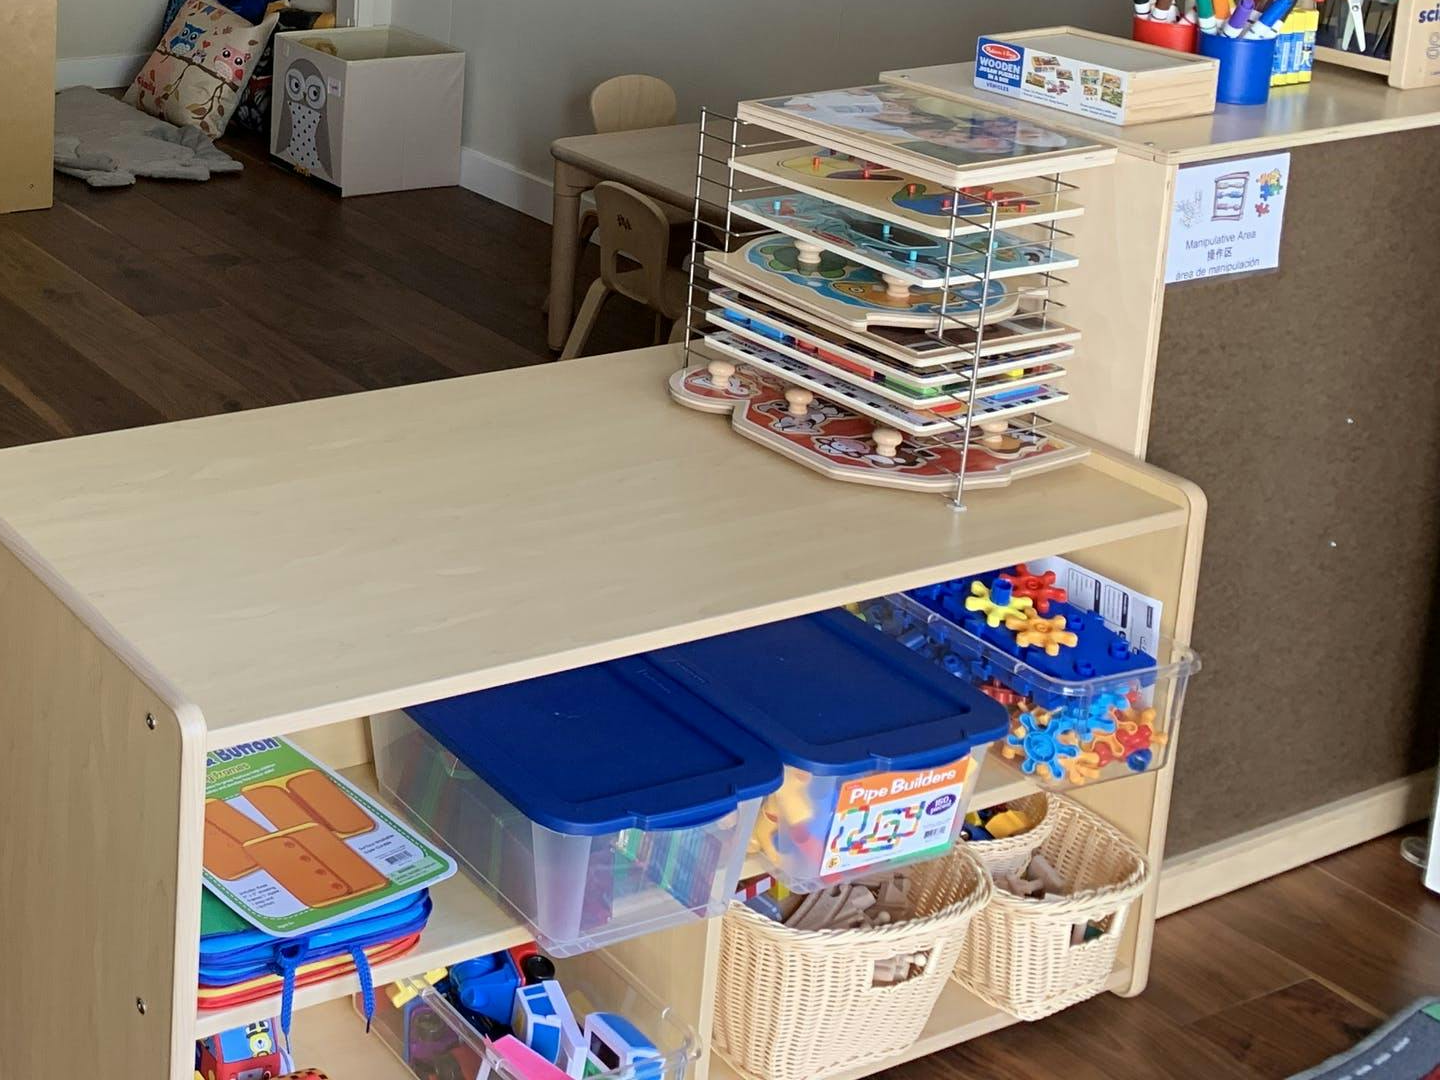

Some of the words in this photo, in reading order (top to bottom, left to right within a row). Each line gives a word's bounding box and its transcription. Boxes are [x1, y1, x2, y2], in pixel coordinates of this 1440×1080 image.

[1418, 3, 1440, 24] sci
[980, 56, 1021, 74] WOODEN
[998, 70, 1020, 80] PUZZLES
[986, 82, 1009, 91] VEHICLES
[1185, 233, 1236, 250] Manipulative
[1237, 230, 1257, 240] Area
[849, 787, 888, 804] Pipe
[890, 768, 957, 795] Builders
